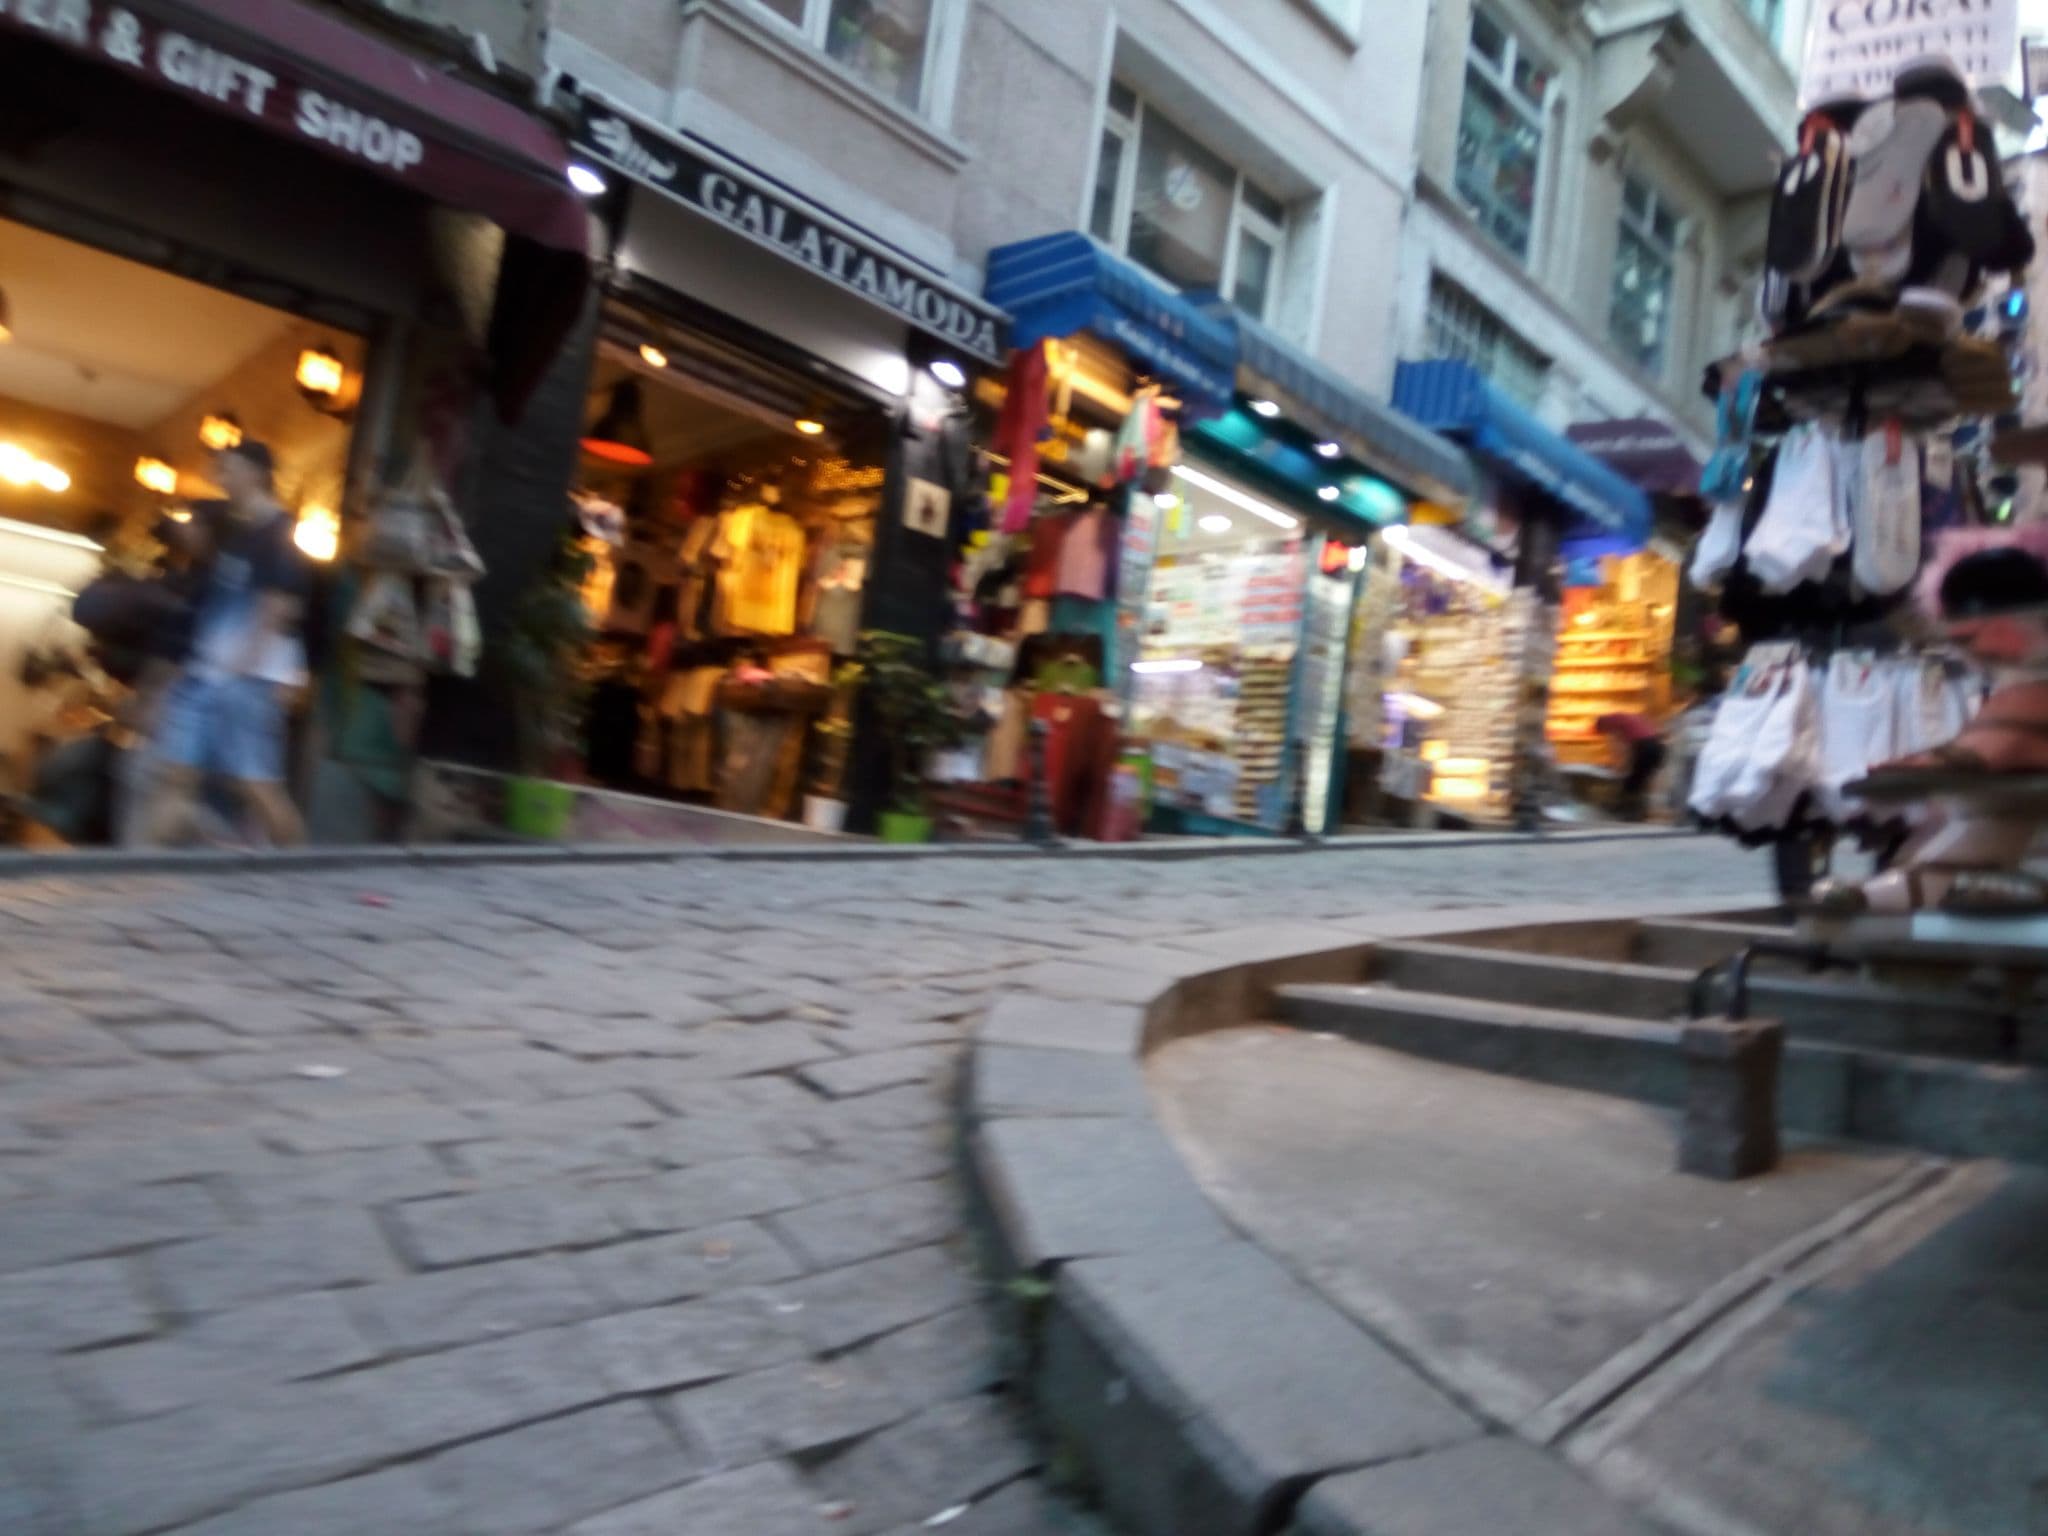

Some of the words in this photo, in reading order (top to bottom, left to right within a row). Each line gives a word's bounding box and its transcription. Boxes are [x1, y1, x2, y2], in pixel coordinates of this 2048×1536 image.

[103, 9, 144, 68] &
[158, 34, 276, 116] GIFT
[294, 91, 424, 170] SHOP
[701, 172, 998, 357] GALATAMODA
